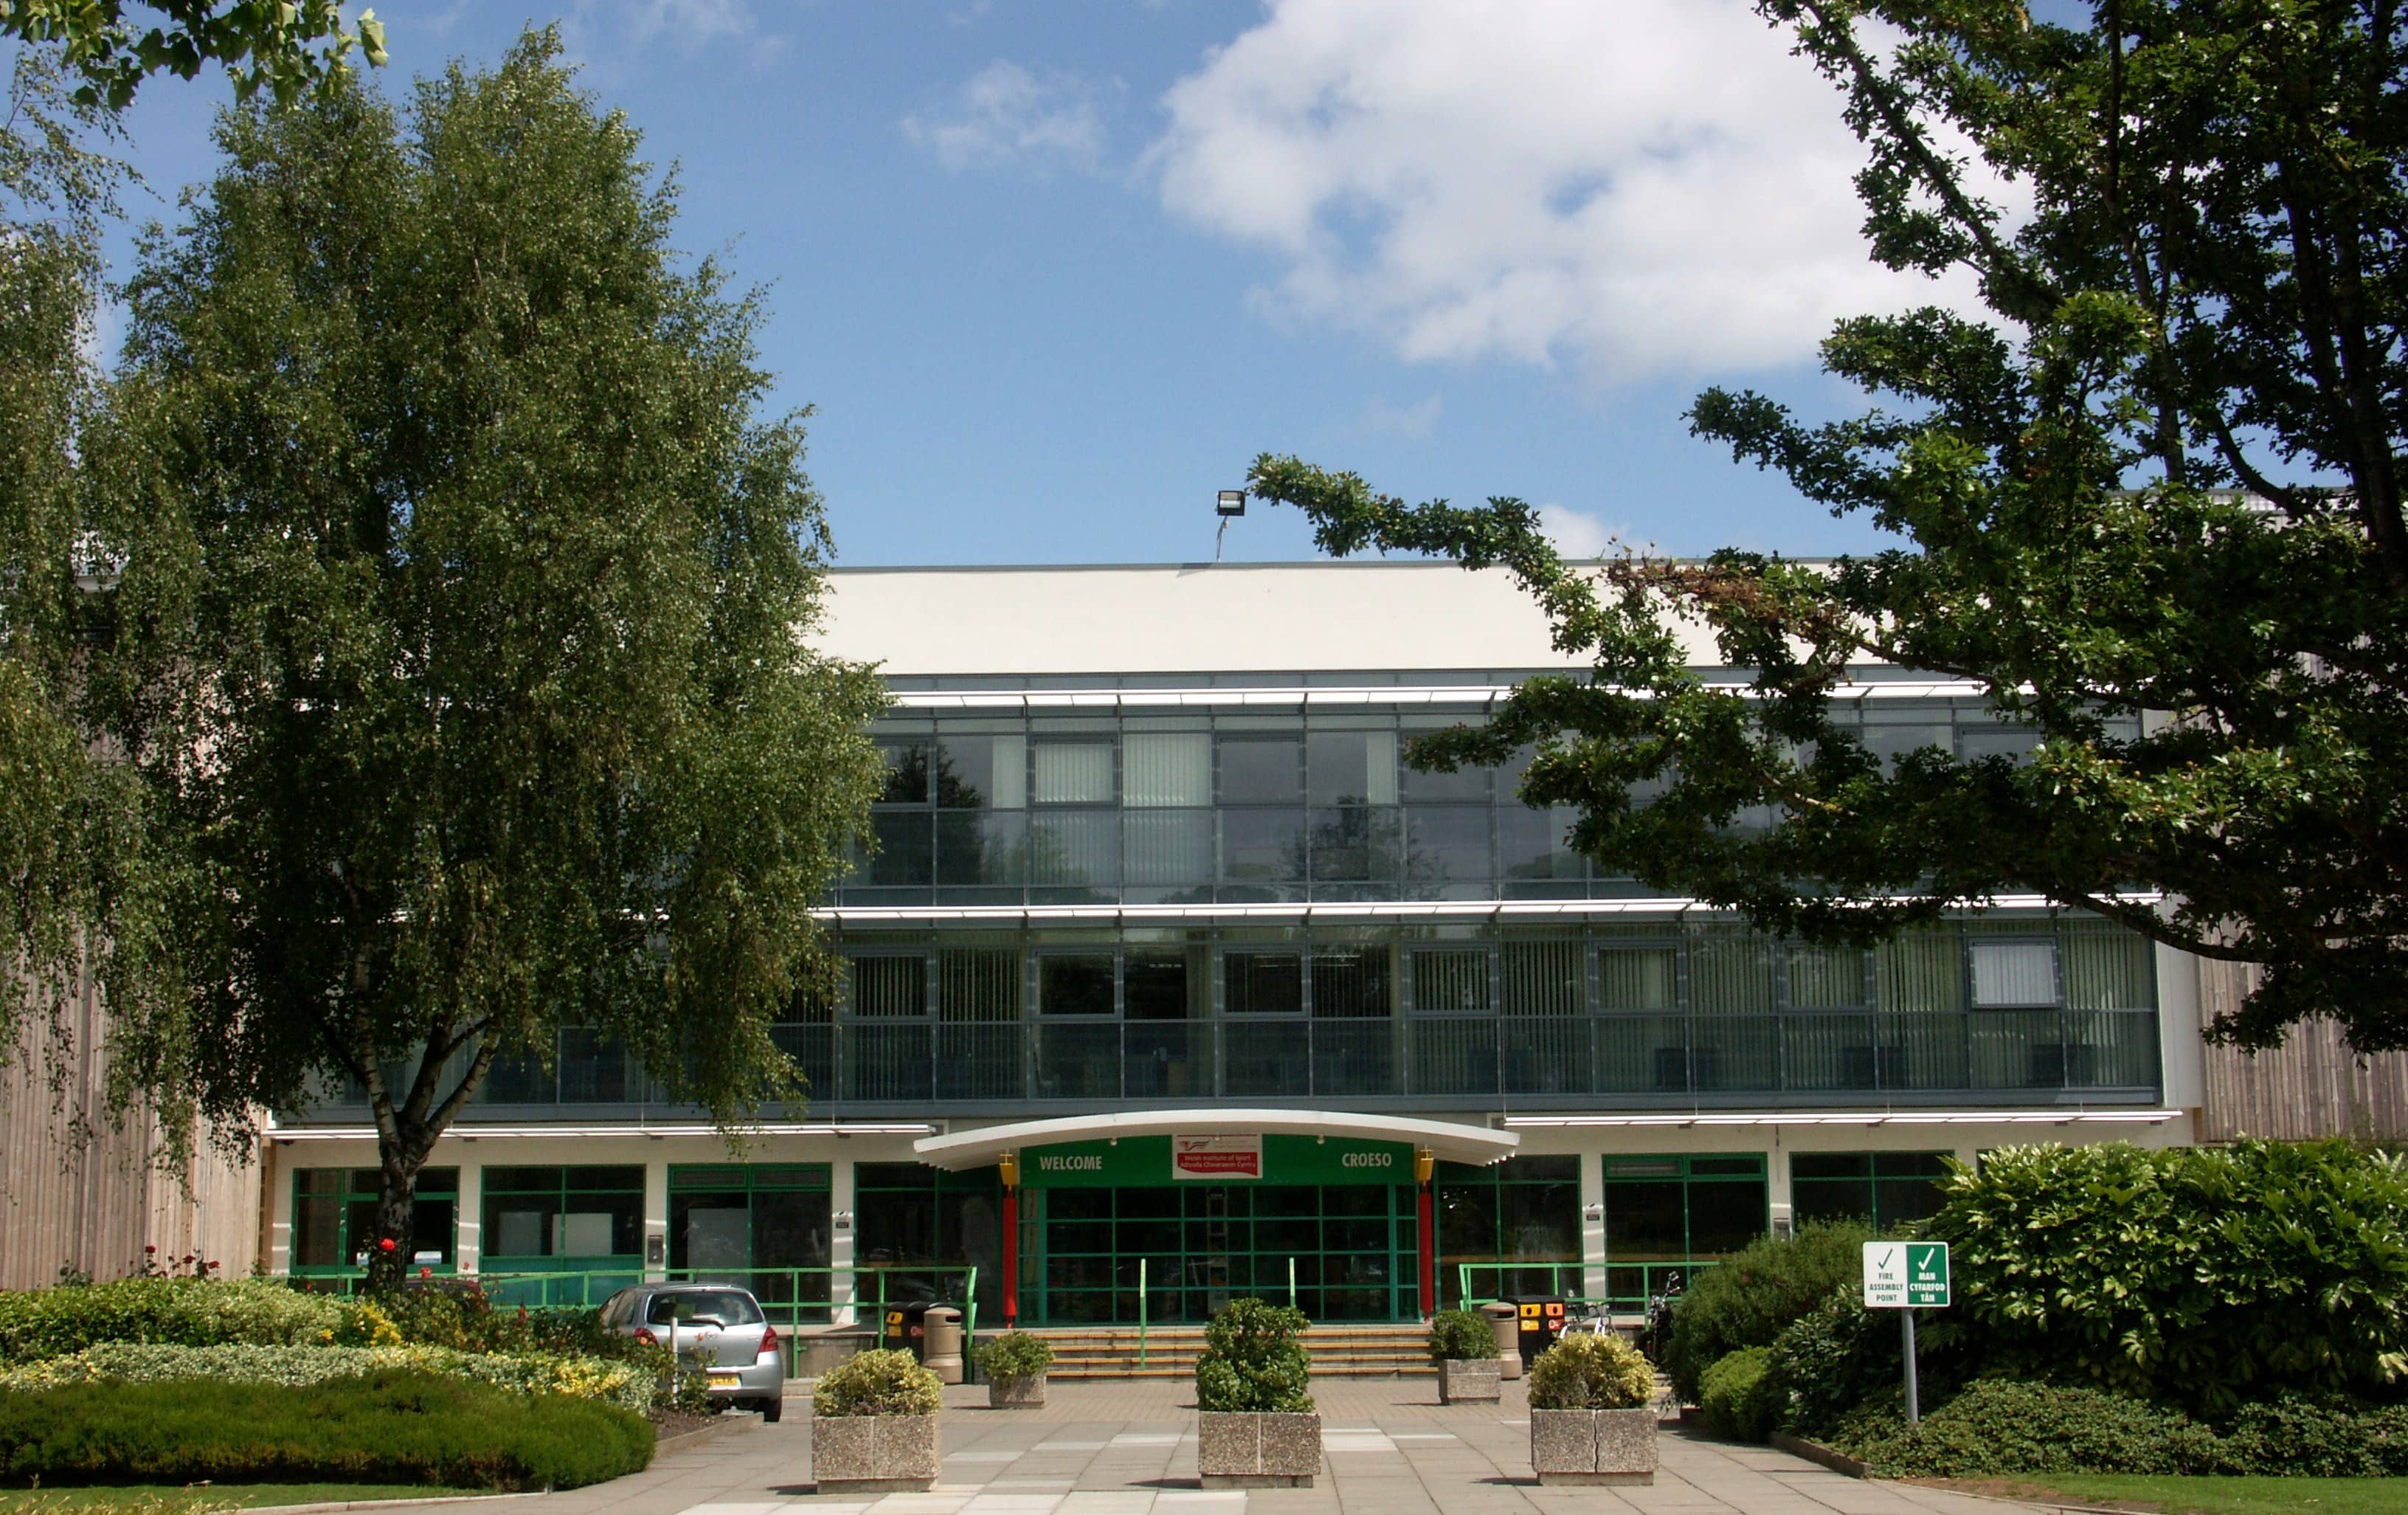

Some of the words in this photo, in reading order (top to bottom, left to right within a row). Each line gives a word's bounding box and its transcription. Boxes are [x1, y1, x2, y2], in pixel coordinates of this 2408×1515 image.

[1039, 1156, 1103, 1170] WELCOME
[1342, 1153, 1392, 1167] CROESO
[1918, 1272, 1936, 1280] MAN
[1909, 1283, 1945, 1291] CYFARFOD
